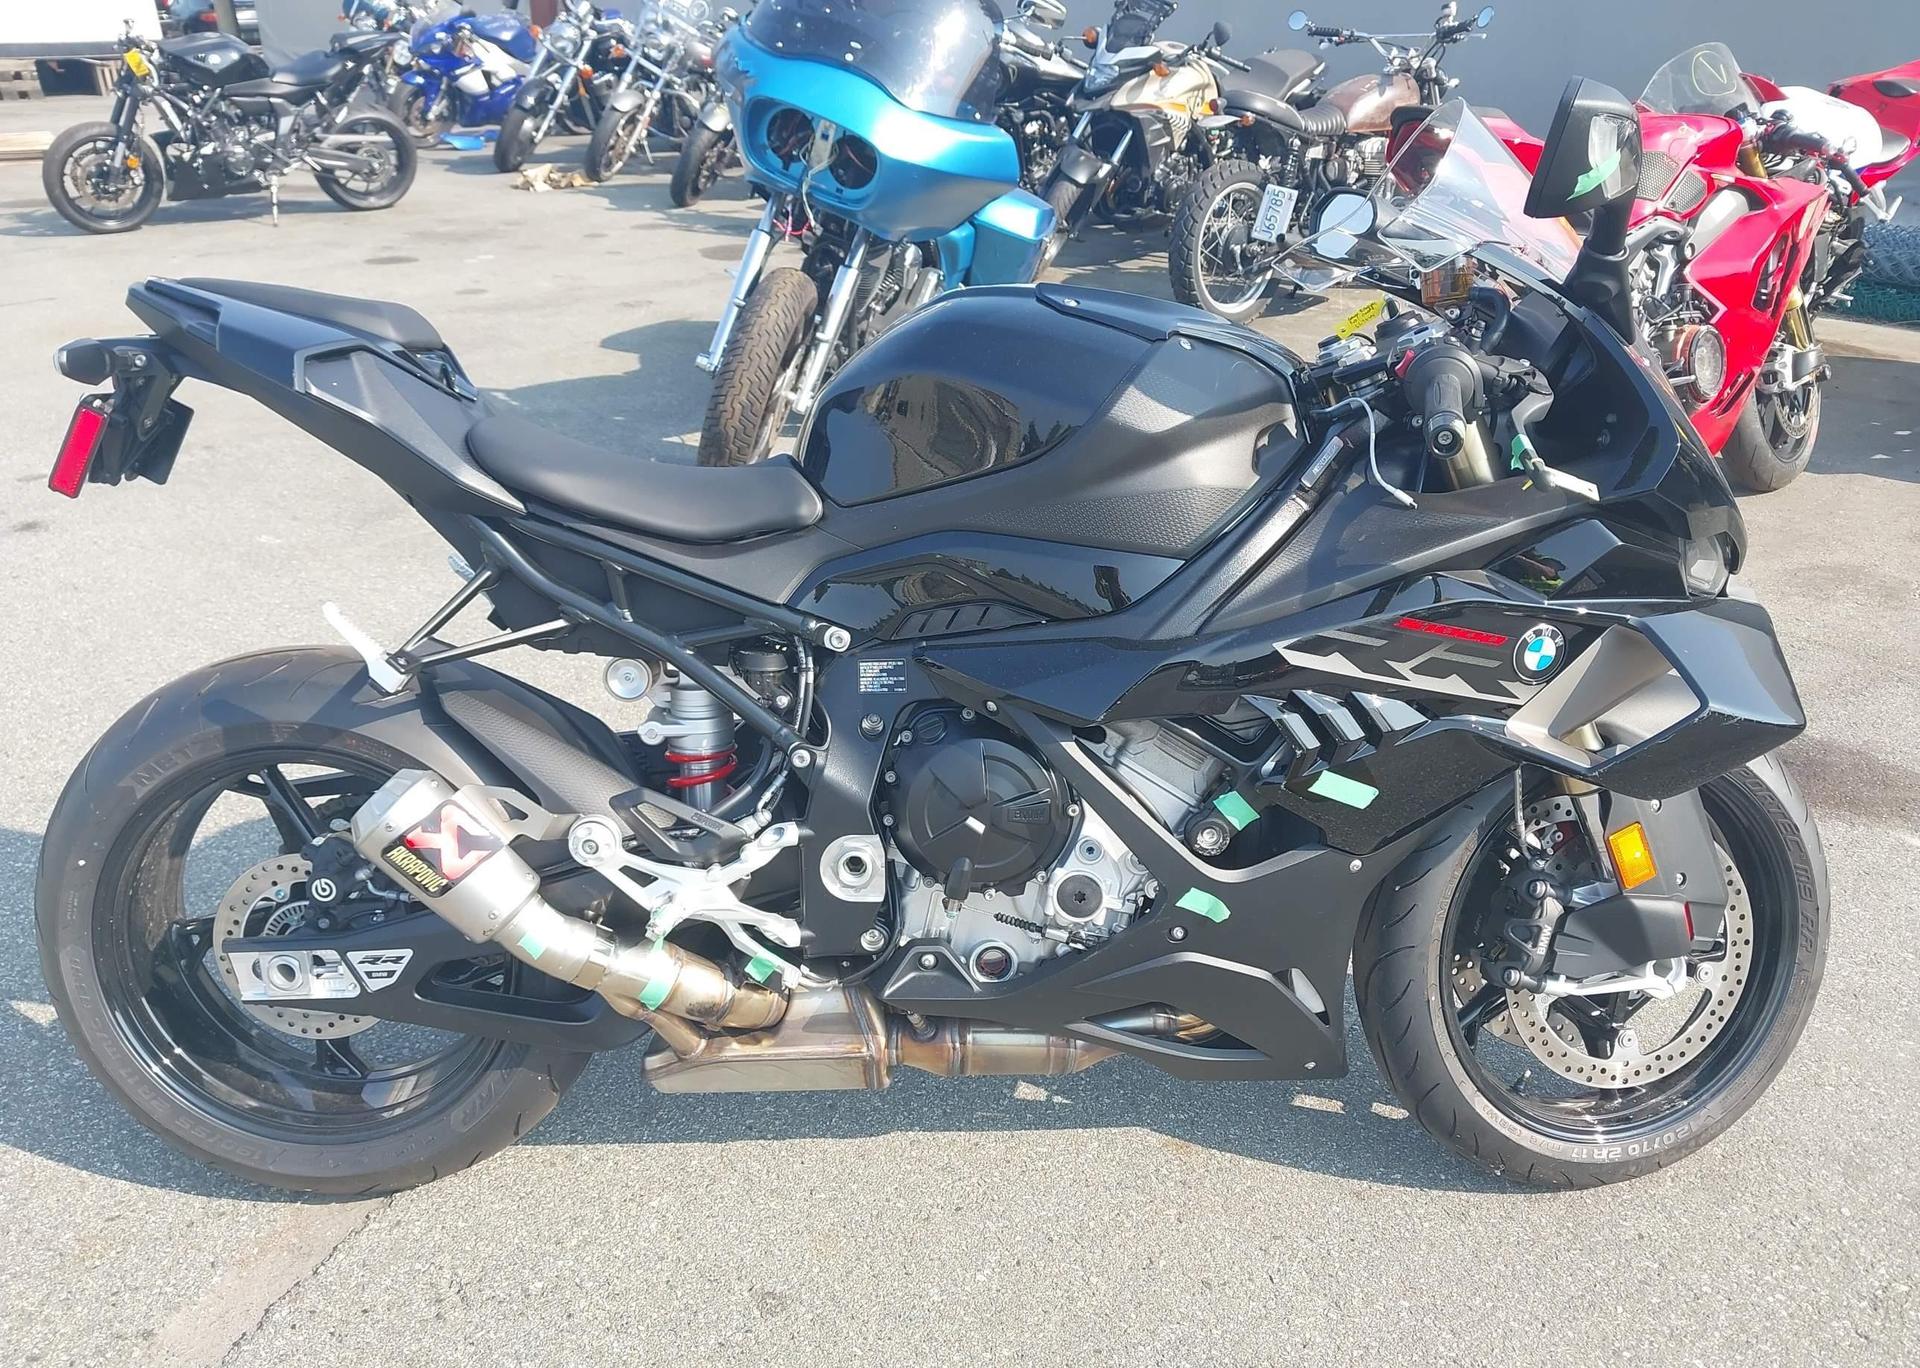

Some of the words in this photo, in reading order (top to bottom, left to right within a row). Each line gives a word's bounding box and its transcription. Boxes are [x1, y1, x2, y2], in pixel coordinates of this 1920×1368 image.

[1261, 188, 1286, 239] J65785
[1012, 808, 1048, 822] BMW
[1537, 924, 1553, 956] BMW
[357, 954, 407, 966] RR
